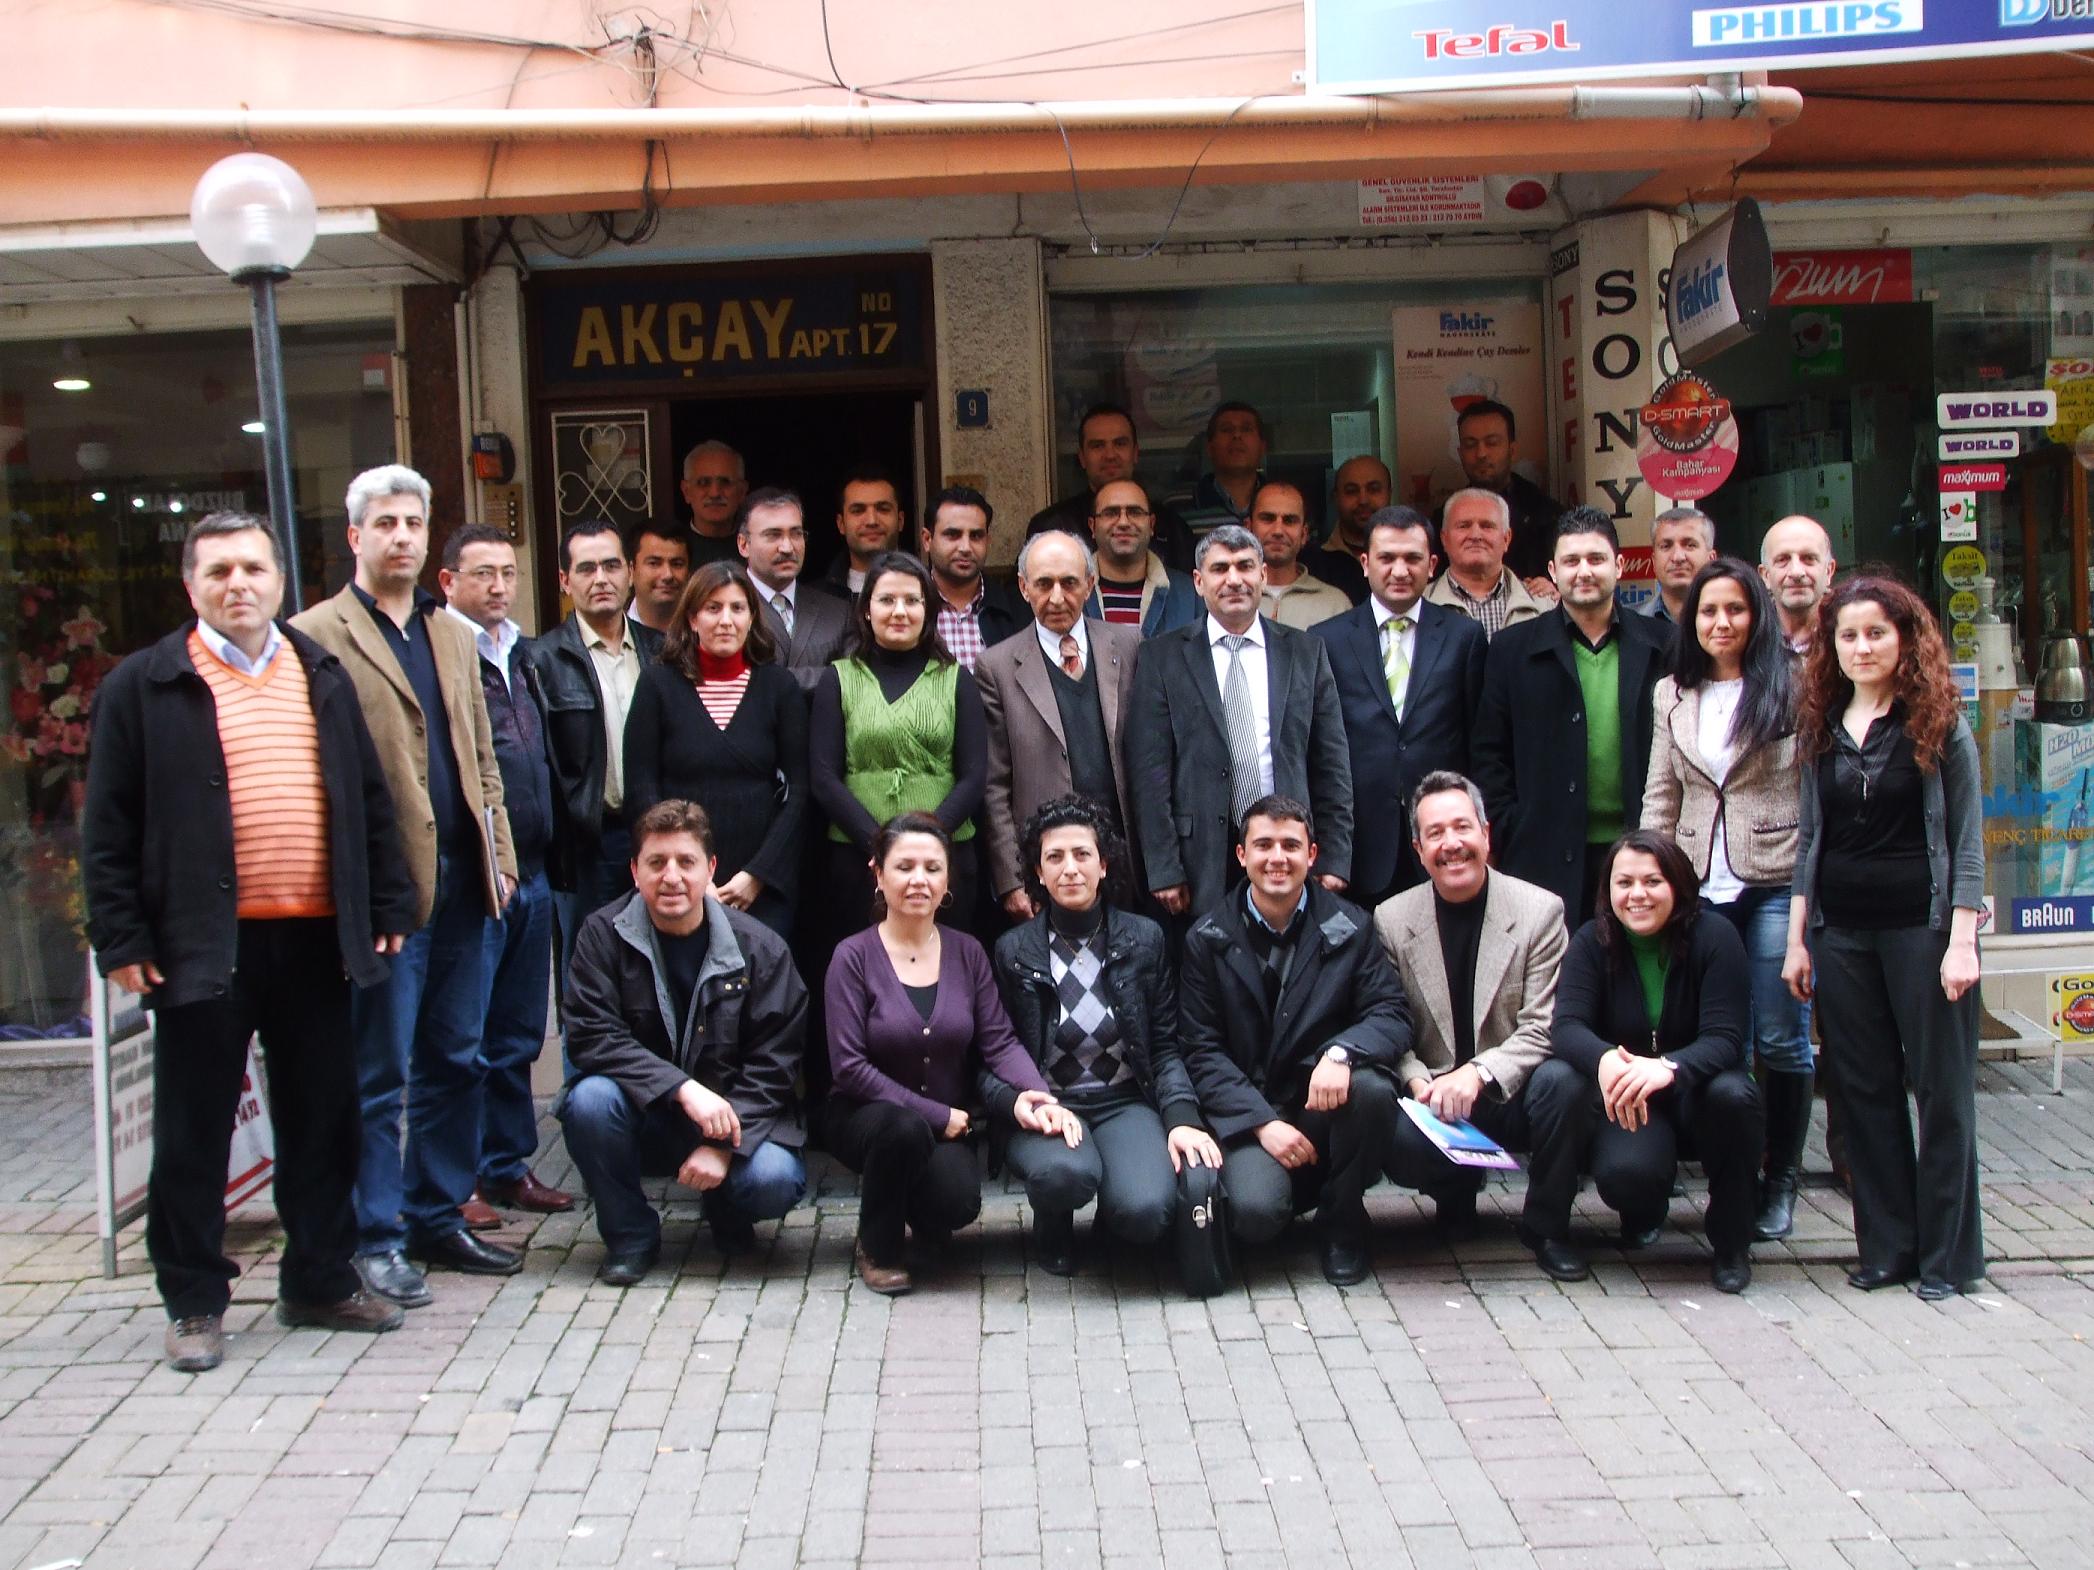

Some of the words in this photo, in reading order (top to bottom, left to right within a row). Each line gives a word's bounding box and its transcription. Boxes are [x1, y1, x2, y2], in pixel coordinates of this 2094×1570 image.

[1709, 1, 1903, 41] PHILIPS
[1413, 21, 1579, 60] Tefal
[862, 292, 892, 313] NO
[572, 299, 794, 378] AKÇAY
[788, 328, 852, 358] APT.
[859, 323, 897, 354] 17
[1407, 348, 1433, 360] Kendi
[1436, 346, 1474, 359] Kendine
[1593, 270, 1643, 518] SONY
[967, 400, 977, 417] 9
[1645, 404, 1724, 422] D-SMART
[1946, 401, 2049, 421] WORLD
[1945, 439, 2014, 453] WORLD
[1663, 465, 1721, 478] Kampanyası
[1943, 469, 2000, 485] maximum
[2021, 902, 2075, 928] BRAUN
